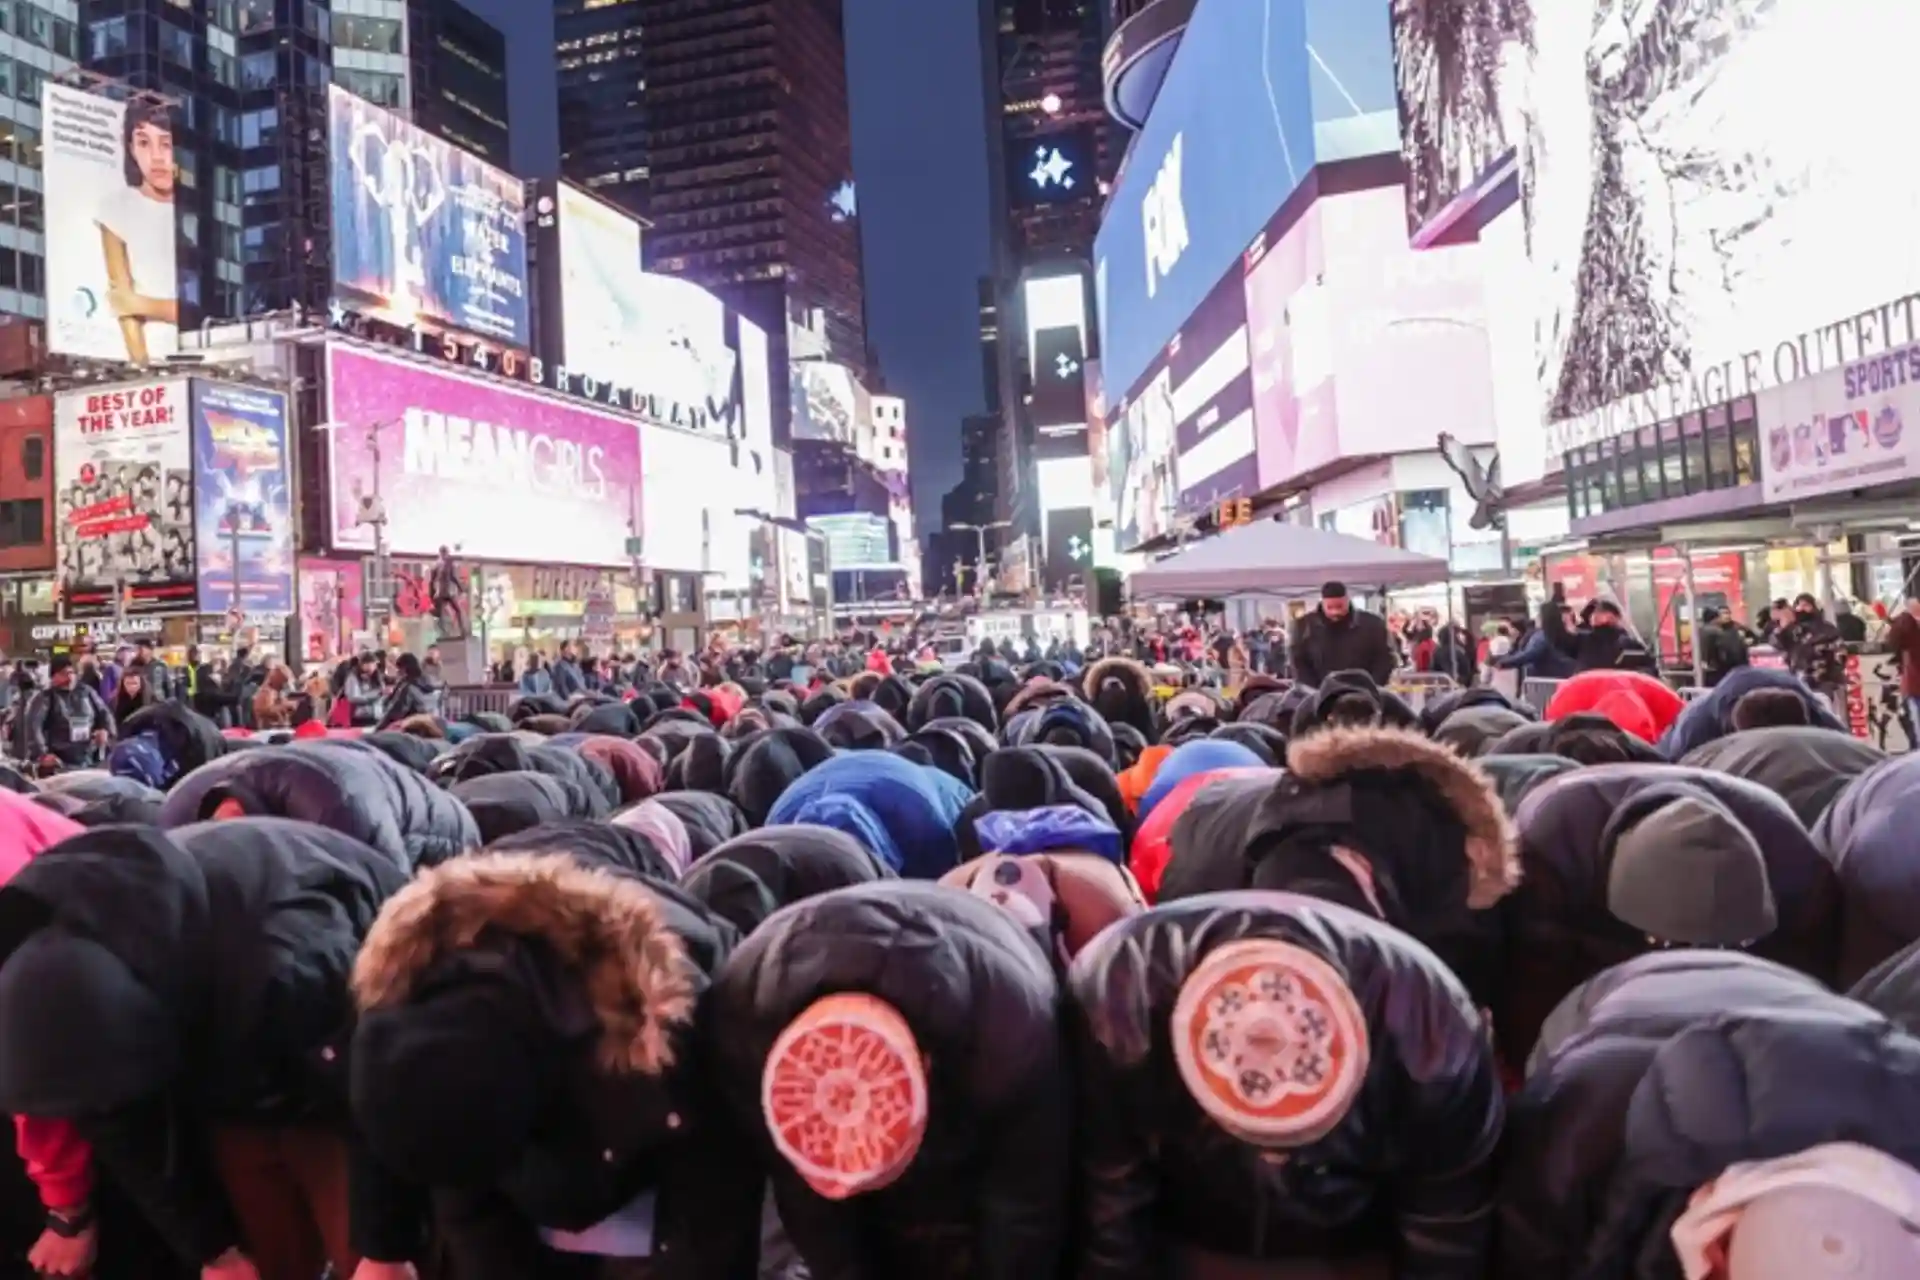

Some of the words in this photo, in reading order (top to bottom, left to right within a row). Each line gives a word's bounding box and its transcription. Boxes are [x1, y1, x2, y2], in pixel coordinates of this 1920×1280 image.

[412, 322, 516, 376] 1540
[86, 390, 136, 413] BEST
[140, 385, 165, 406] OF
[1667, 350, 1763, 419] EAGLE
[77, 413, 114, 434] THE
[119, 405, 174, 428] YEAR!
[403, 406, 530, 486] MEAN
[529, 434, 605, 501] GIRLS
